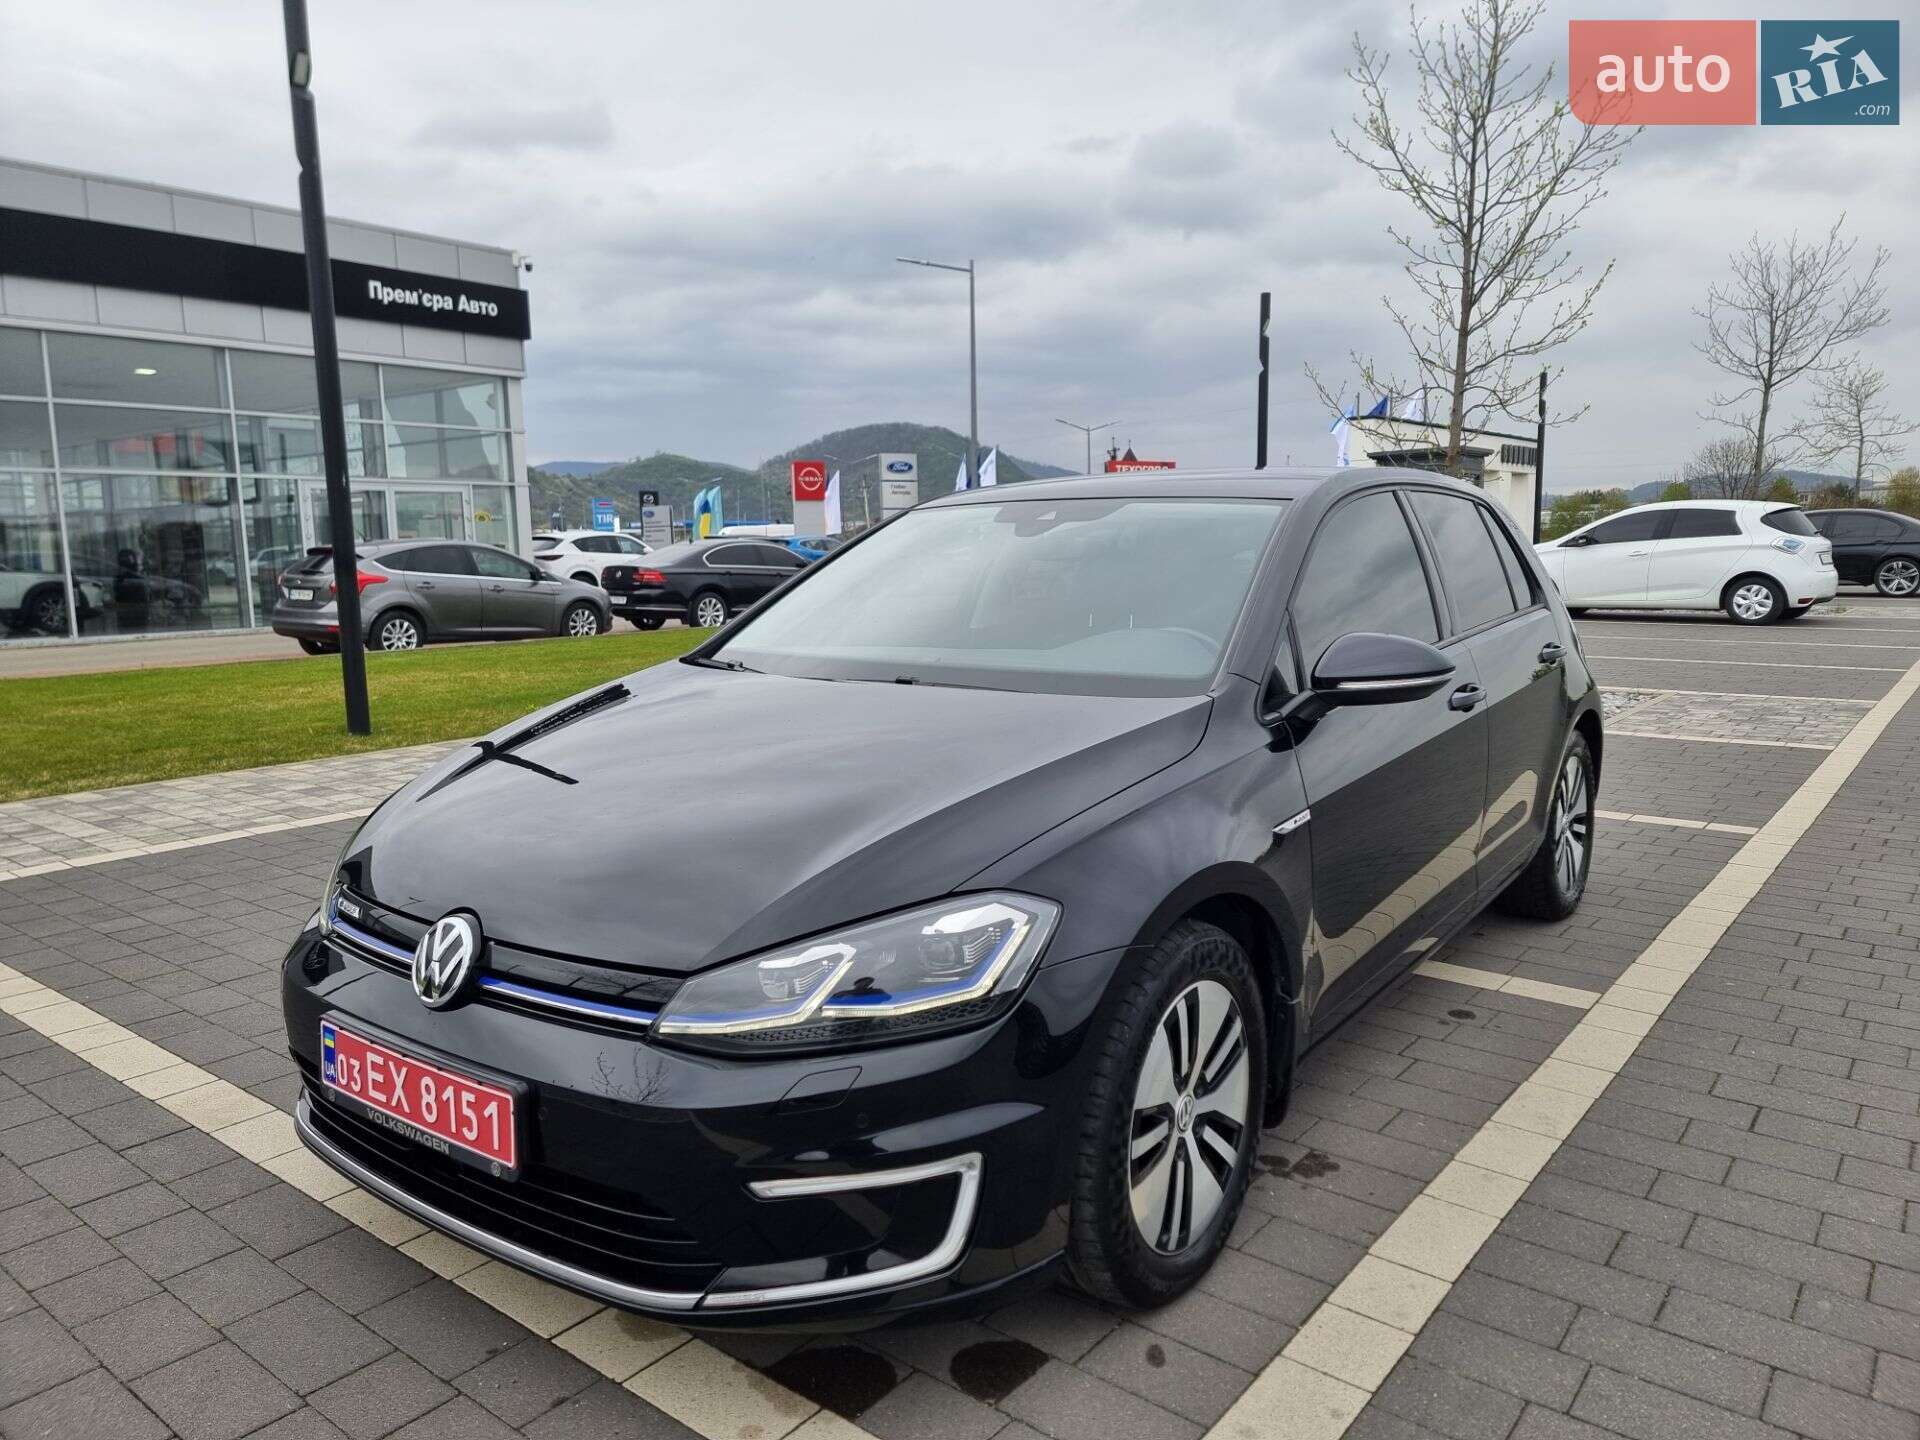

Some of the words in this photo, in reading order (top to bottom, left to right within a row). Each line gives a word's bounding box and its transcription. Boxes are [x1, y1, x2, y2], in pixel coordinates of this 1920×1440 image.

[458, 294, 499, 317] Авто
[596, 513, 613, 524] TIR
[325, 1061, 336, 1079] UA
[337, 1053, 362, 1093] 03
[366, 1051, 411, 1114] EX
[420, 1076, 501, 1151] 8151
[366, 1107, 450, 1155] VOLKSWAGEN
